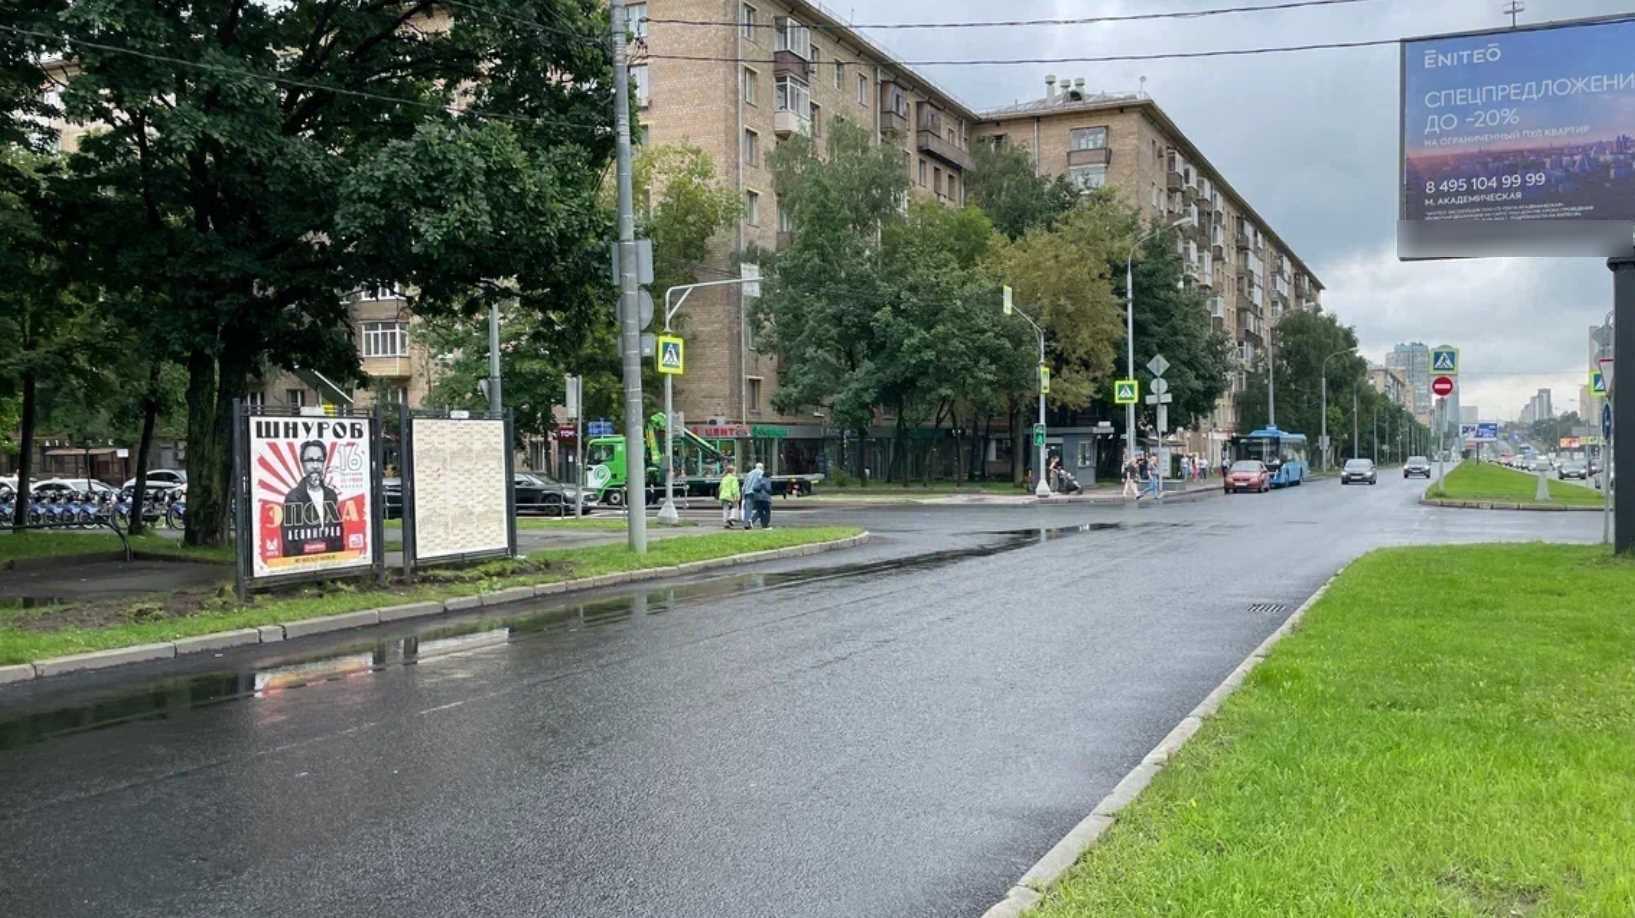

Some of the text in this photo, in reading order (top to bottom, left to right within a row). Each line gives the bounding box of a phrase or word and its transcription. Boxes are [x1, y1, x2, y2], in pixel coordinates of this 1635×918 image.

[1424, 108, 1520, 135] ДО -20%
[1424, 138, 1438, 147] НА
[1439, 132, 1520, 146] ОГРАНИЧЕННЫЙ
[1545, 126, 1590, 137] КВАРТИР
[1425, 172, 1546, 194] 8 495 104 99 99
[1424, 192, 1522, 207] М. АКАДЕМИЧЕСКАЯ
[256, 421, 364, 439] ШНУРОВ
[337, 443, 363, 471] 16
[264, 499, 360, 528] ЭПОХА
